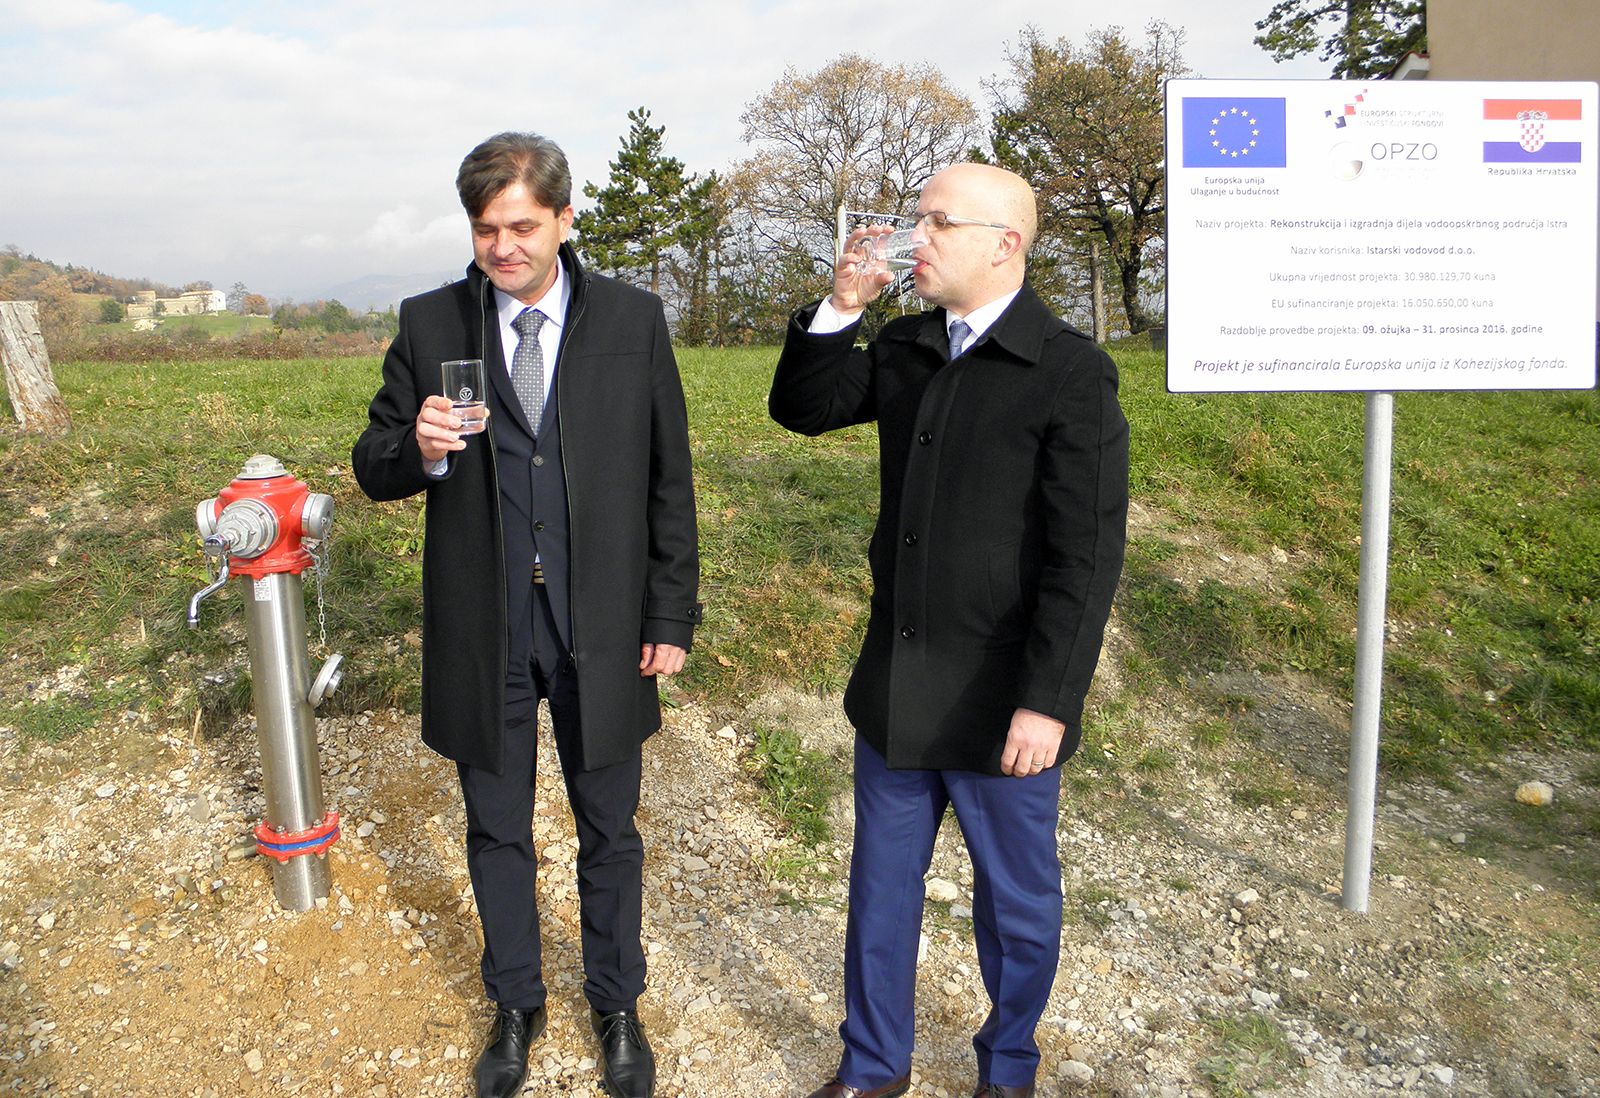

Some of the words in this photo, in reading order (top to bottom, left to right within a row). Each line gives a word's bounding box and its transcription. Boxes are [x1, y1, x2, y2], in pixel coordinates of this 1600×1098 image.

[1360, 110, 1396, 118] EUROPSKI
[1371, 142, 1438, 161] OPZO
[1487, 167, 1533, 176] Republika
[1536, 167, 1577, 176] Hrvatska
[1204, 176, 1243, 186] Europska
[1244, 176, 1265, 186] unija
[1190, 187, 1227, 197] Ulaganje
[1236, 186, 1280, 196] budućnost
[1195, 219, 1222, 229] Naziv
[1224, 219, 1268, 231] projekta:
[1270, 218, 1342, 230] Rekonstrukcija
[1349, 219, 1394, 231] izgradnja
[1396, 218, 1423, 231] dijela
[1425, 219, 1500, 231] vodoopskrbnog
[1547, 219, 1568, 229] Istra
[1290, 245, 1317, 255] Naziv
[1319, 245, 1364, 255] korisnika:
[1366, 245, 1401, 255] Istarski
[1403, 245, 1446, 255] vodovod
[1448, 245, 1476, 255] d.o.o.
[1269, 272, 1306, 283] Ukupna
[1308, 272, 1357, 283] vrijednost
[1359, 272, 1401, 284] projekta:
[1403, 271, 1472, 282] 30.980.129,70
[1473, 272, 1496, 281] kuna
[1271, 299, 1285, 309] EU
[1287, 298, 1355, 310] sufinanciranje
[1357, 298, 1400, 310] projekta:
[1402, 298, 1469, 309] 16.050.650,00
[1471, 298, 1494, 308] kuna
[1219, 325, 1267, 337] Razdoblje
[1269, 325, 1315, 337] provedbe
[1317, 325, 1360, 337] projekta:
[1362, 325, 1378, 335] 09.
[1380, 324, 1411, 336] ožujka
[1422, 324, 1437, 334] 31.
[1439, 324, 1480, 336] prosinca
[1482, 324, 1508, 334] 2016.
[1510, 324, 1543, 336] godine
[1193, 359, 1240, 374] Projekt
[1241, 360, 1255, 374] je
[1257, 358, 1341, 374] sufinancirala
[1344, 358, 1402, 372] Europska
[1405, 358, 1437, 372] unija
[1439, 358, 1450, 371] iz
[1453, 358, 1526, 372] Kohezijskog
[1527, 356, 1569, 372] fonda.
